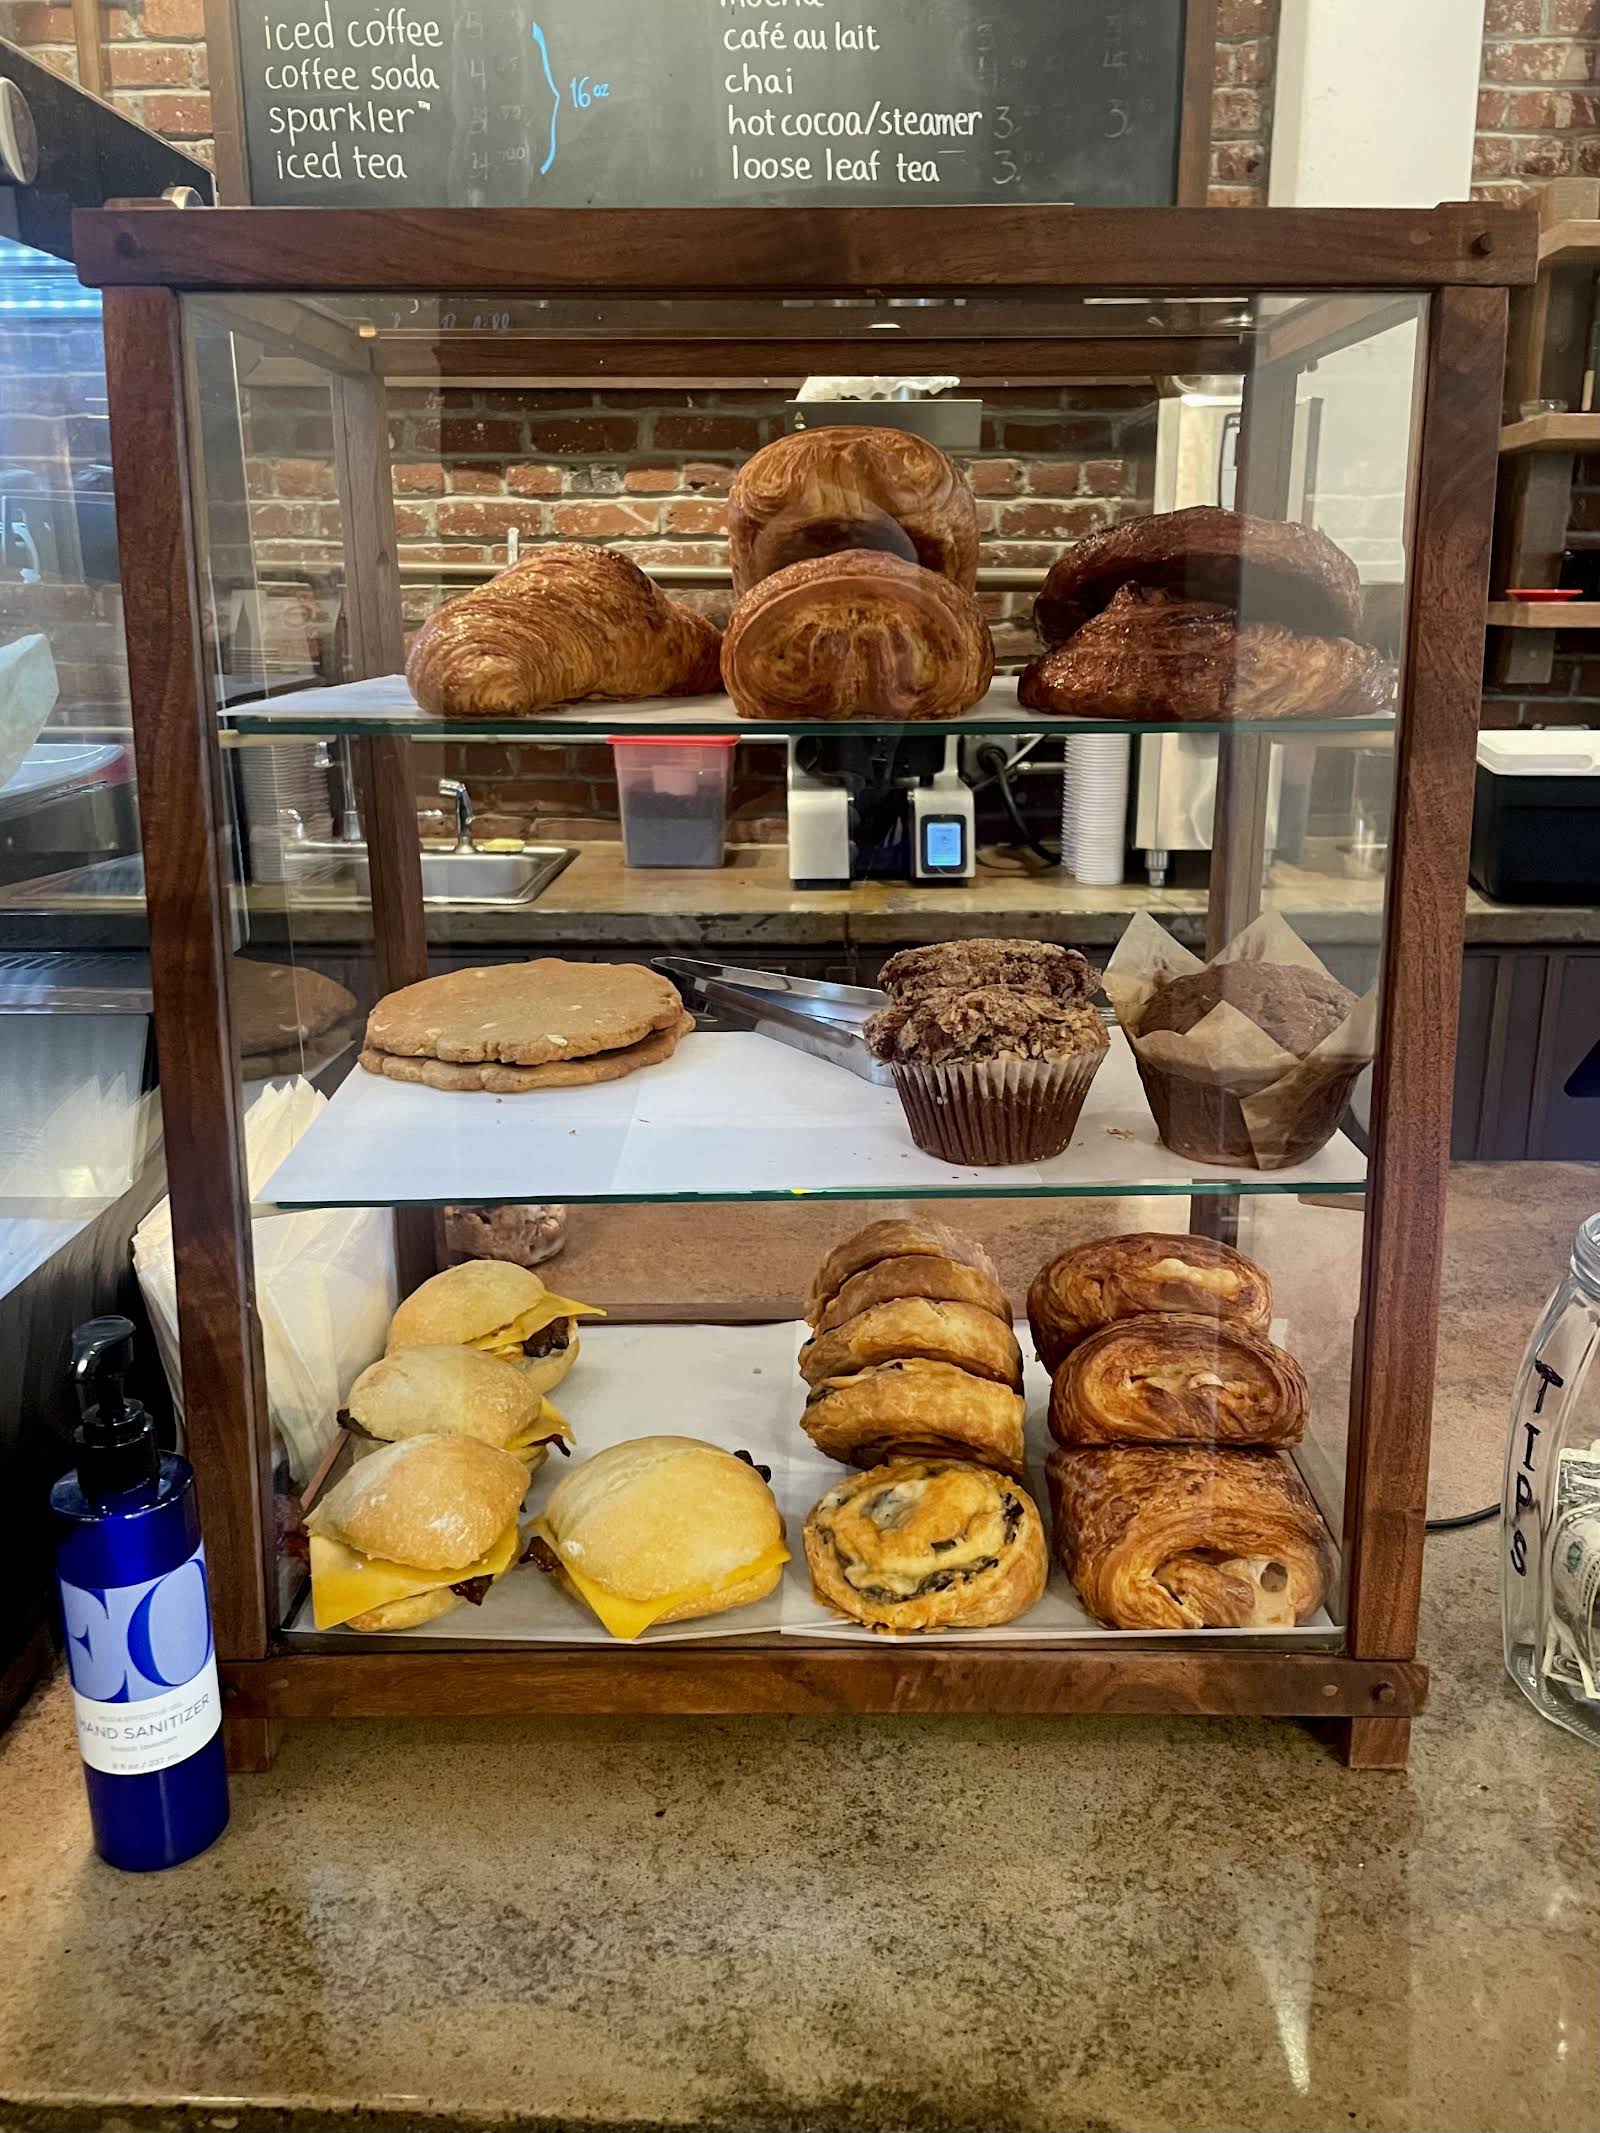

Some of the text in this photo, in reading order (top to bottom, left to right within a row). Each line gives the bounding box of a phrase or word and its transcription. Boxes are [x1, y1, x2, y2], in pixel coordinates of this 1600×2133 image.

[265, 1, 334, 51] iced
[348, 7, 444, 48] coffee
[723, 21, 881, 51] café au lait
[265, 54, 440, 91] coffee soda
[725, 63, 793, 95] chai
[728, 101, 983, 137] hot cocoa/steamer
[276, 140, 408, 180] iced tea
[732, 145, 940, 182] loose leaf tea
[1510, 1359, 1565, 1577] TIPS
[79, 1714, 119, 1740] HAND
[123, 1693, 210, 1740] SANITIZER
